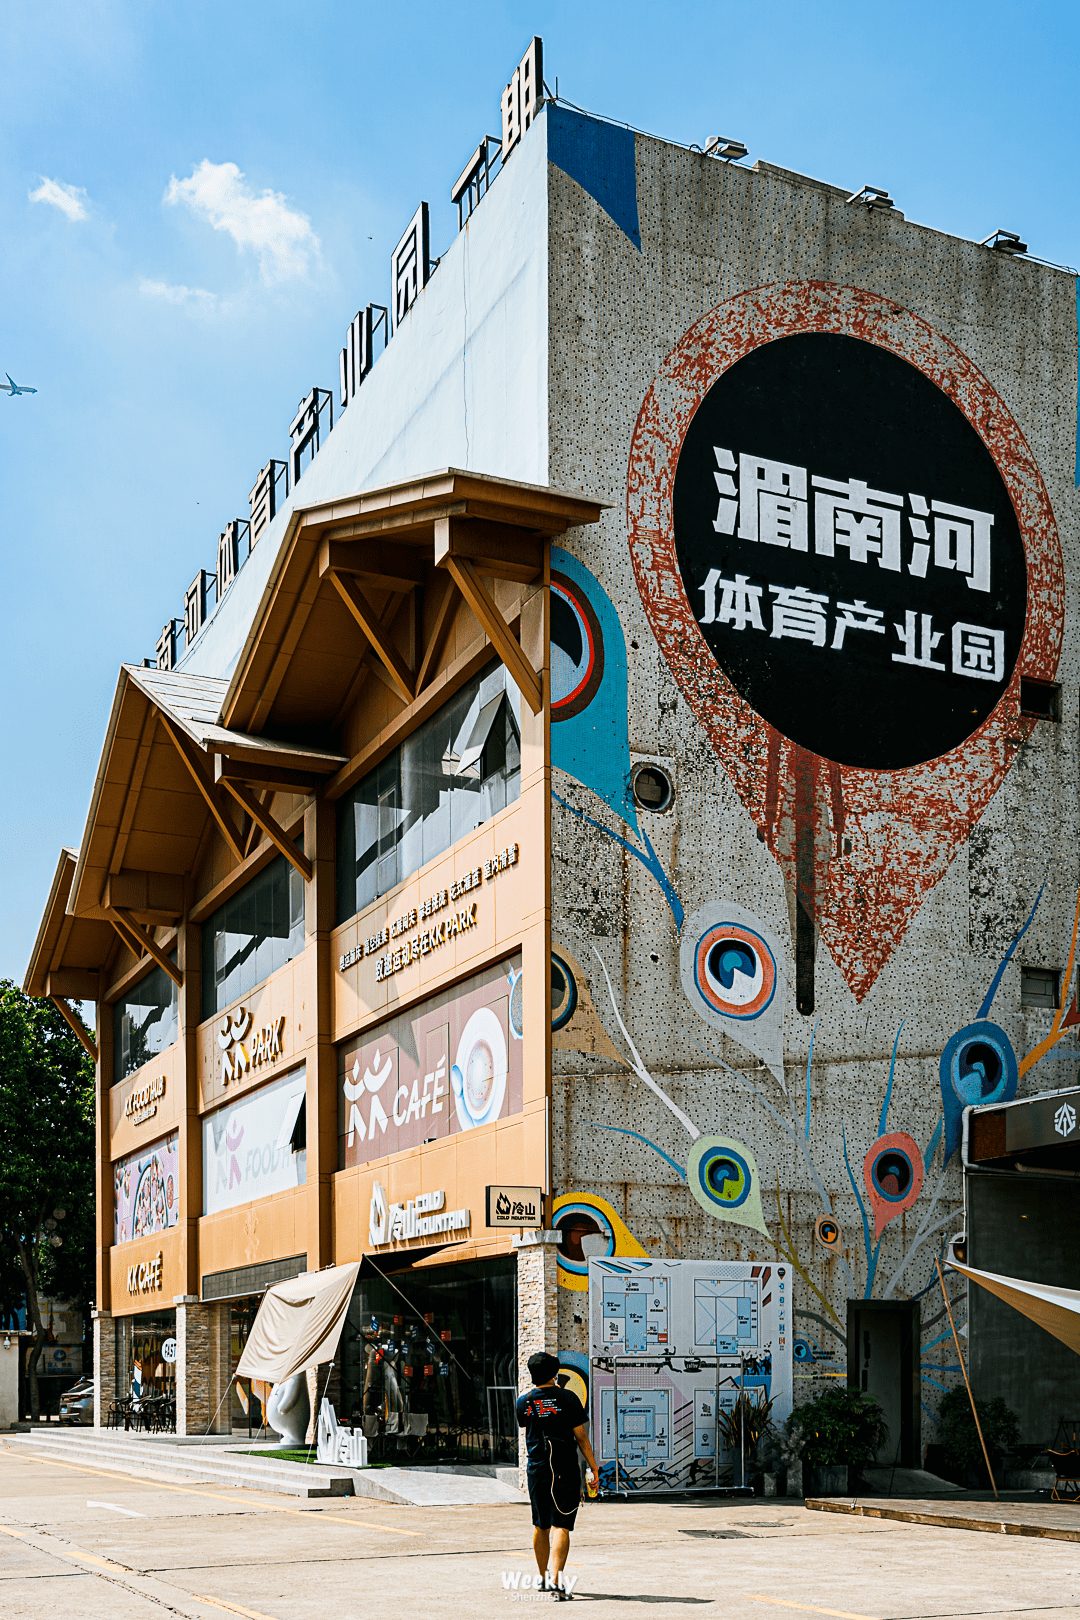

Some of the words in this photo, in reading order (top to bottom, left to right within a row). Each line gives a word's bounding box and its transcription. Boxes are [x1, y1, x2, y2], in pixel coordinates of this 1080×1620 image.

[140, 36, 543, 671] 南河体育产业园一期
[698, 568, 1005, 682] 体育产业园
[445, 902, 477, 940] PARK
[250, 1016, 286, 1068] PARK
[133, 1083, 150, 1112] FOOD
[151, 1075, 165, 1101] HUB
[393, 1054, 446, 1127] CAFÉ
[245, 1139, 280, 1182] FOOD
[415, 1190, 445, 1214] COLD
[416, 1208, 470, 1237] MOUNTAIN
[512, 1202, 536, 1215] 冷山
[127, 1264, 140, 1292] KK
[139, 1250, 162, 1290] CAFÉ
